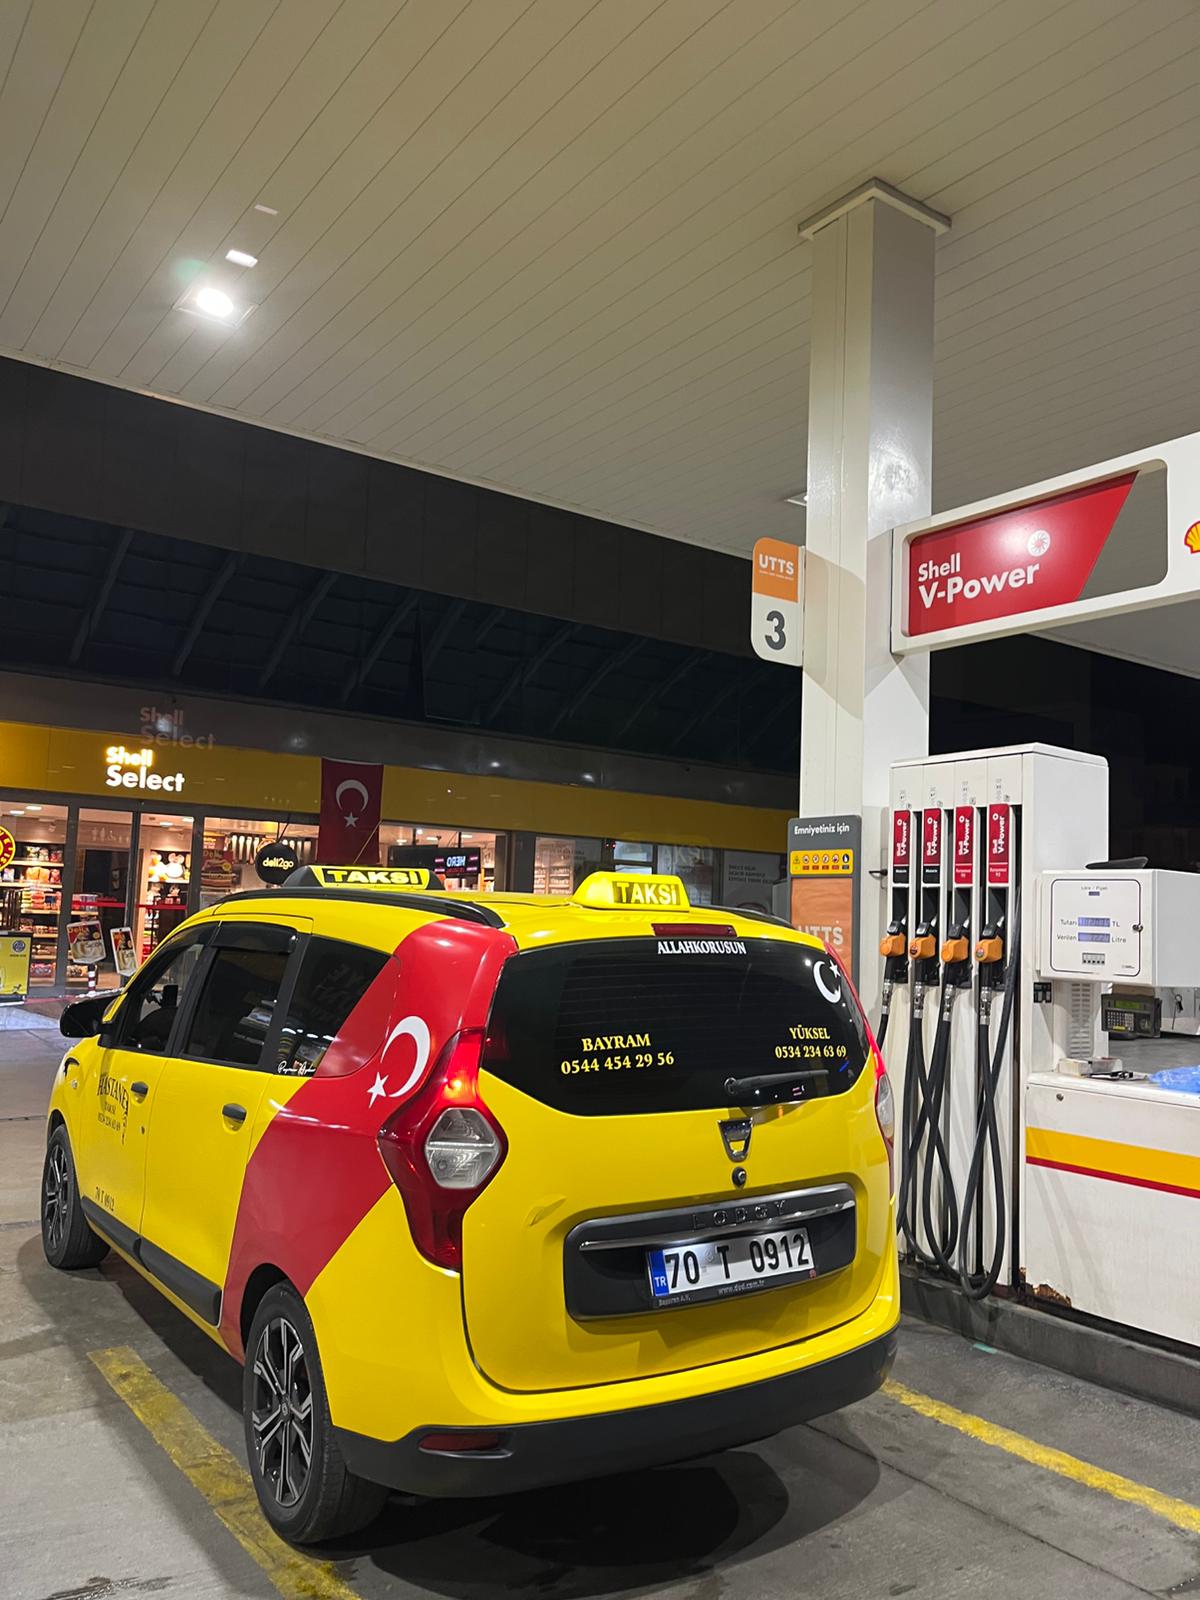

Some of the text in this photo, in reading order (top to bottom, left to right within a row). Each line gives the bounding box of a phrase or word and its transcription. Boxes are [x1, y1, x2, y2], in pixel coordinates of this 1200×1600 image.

[759, 553, 794, 576] UTTS
[917, 552, 961, 582] Shell
[918, 563, 1040, 609] V-Power
[764, 609, 787, 651] 3
[106, 746, 154, 767] Shell
[106, 766, 185, 792] Select
[794, 822, 850, 836] Emniyetiniz için
[930, 820, 939, 856] V-Power
[962, 819, 971, 855] V-Power
[997, 816, 1006, 854] V-Power
[262, 857, 294, 871] deli2go
[657, 940, 747, 955] ALLAHKORUSUN
[582, 1034, 651, 1052] BAYRAM
[789, 1024, 830, 1040] YÜKSEL
[775, 1045, 847, 1058] 0534 234 63 69
[561, 1052, 675, 1075] 0544 454 29 56
[664, 1234, 810, 1289] 70 T 0912
[654, 1276, 667, 1287] TR
